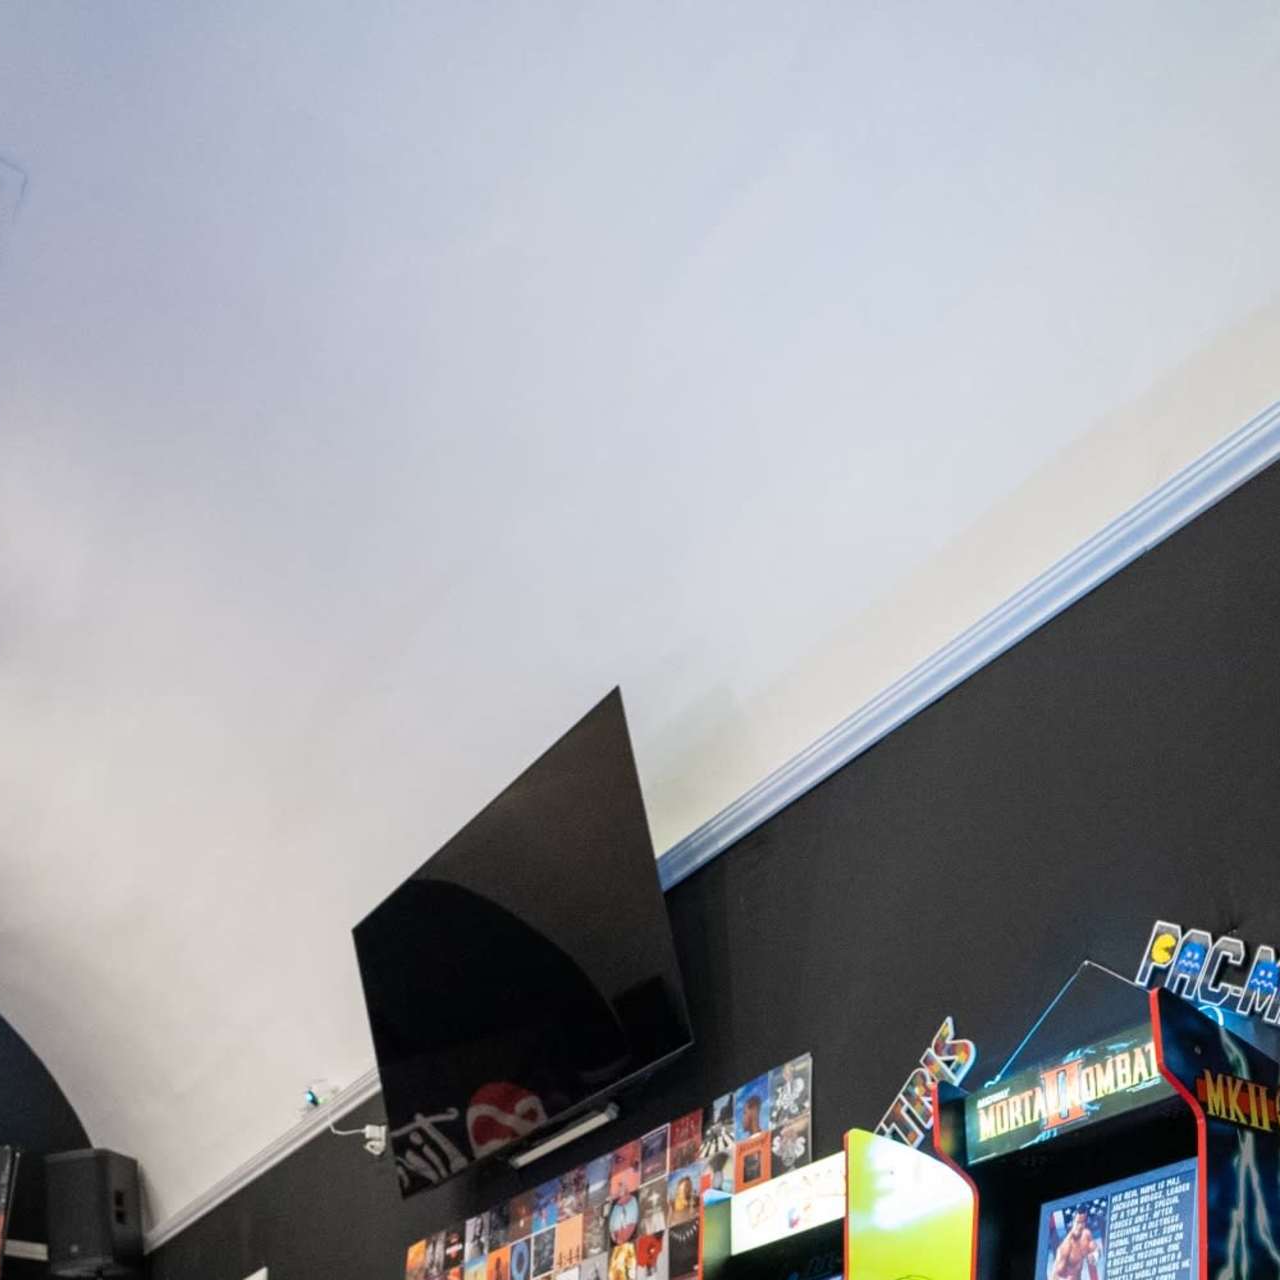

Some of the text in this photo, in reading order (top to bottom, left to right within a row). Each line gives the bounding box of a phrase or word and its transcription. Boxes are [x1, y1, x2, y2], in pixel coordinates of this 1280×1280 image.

[977, 1087, 1048, 1142] MORTA
[1078, 1041, 1160, 1100] OMBAT
[1204, 1069, 1271, 1132] MKII
